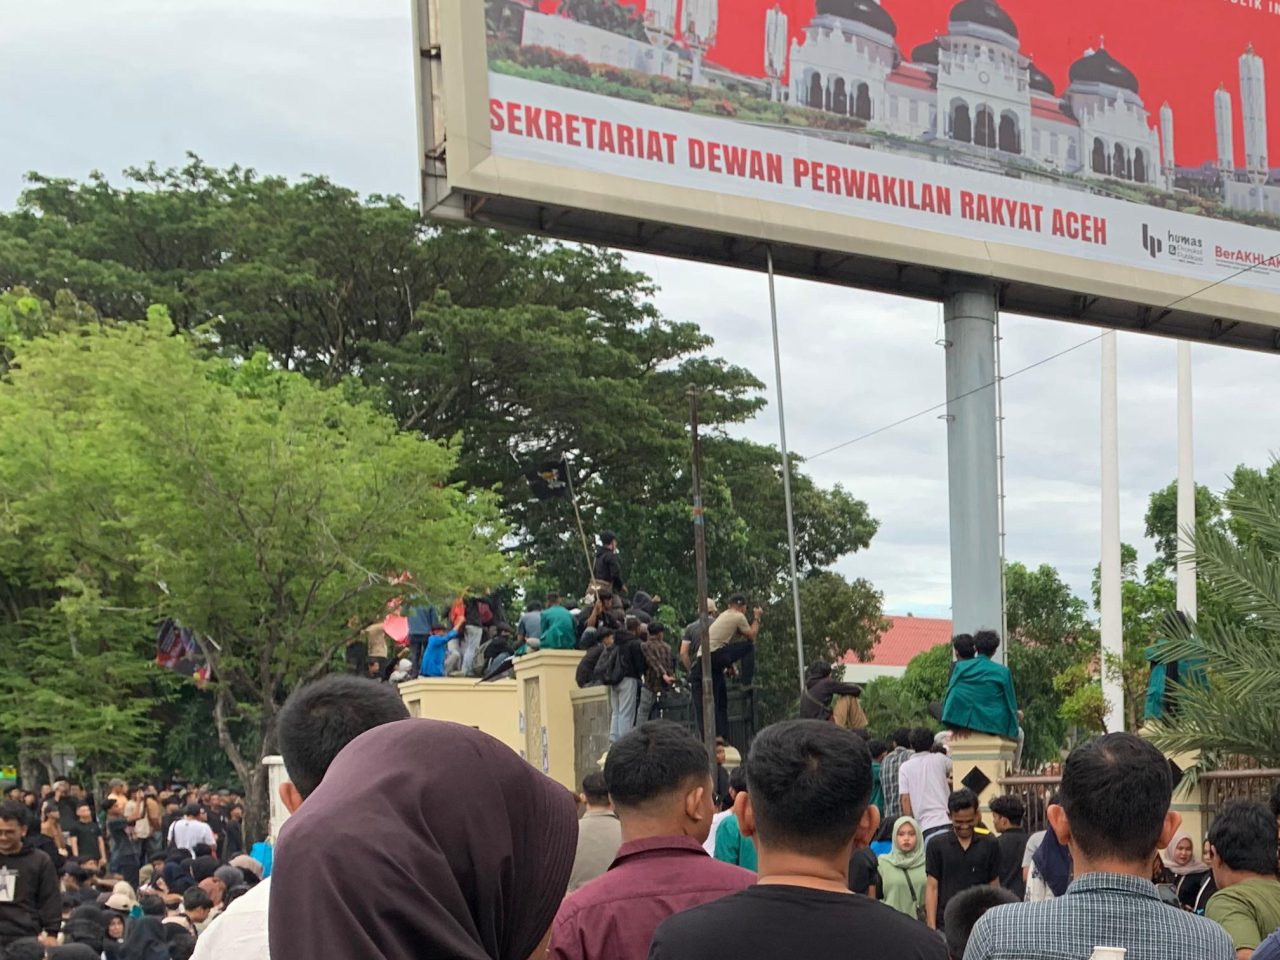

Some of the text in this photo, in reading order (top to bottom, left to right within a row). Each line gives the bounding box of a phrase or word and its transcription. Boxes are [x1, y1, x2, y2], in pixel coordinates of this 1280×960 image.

[489, 98, 1107, 246] SEKRETARIAT DEWAN PERWAKILAN RAKYAT ACEH
[1168, 230, 1203, 247] humas
